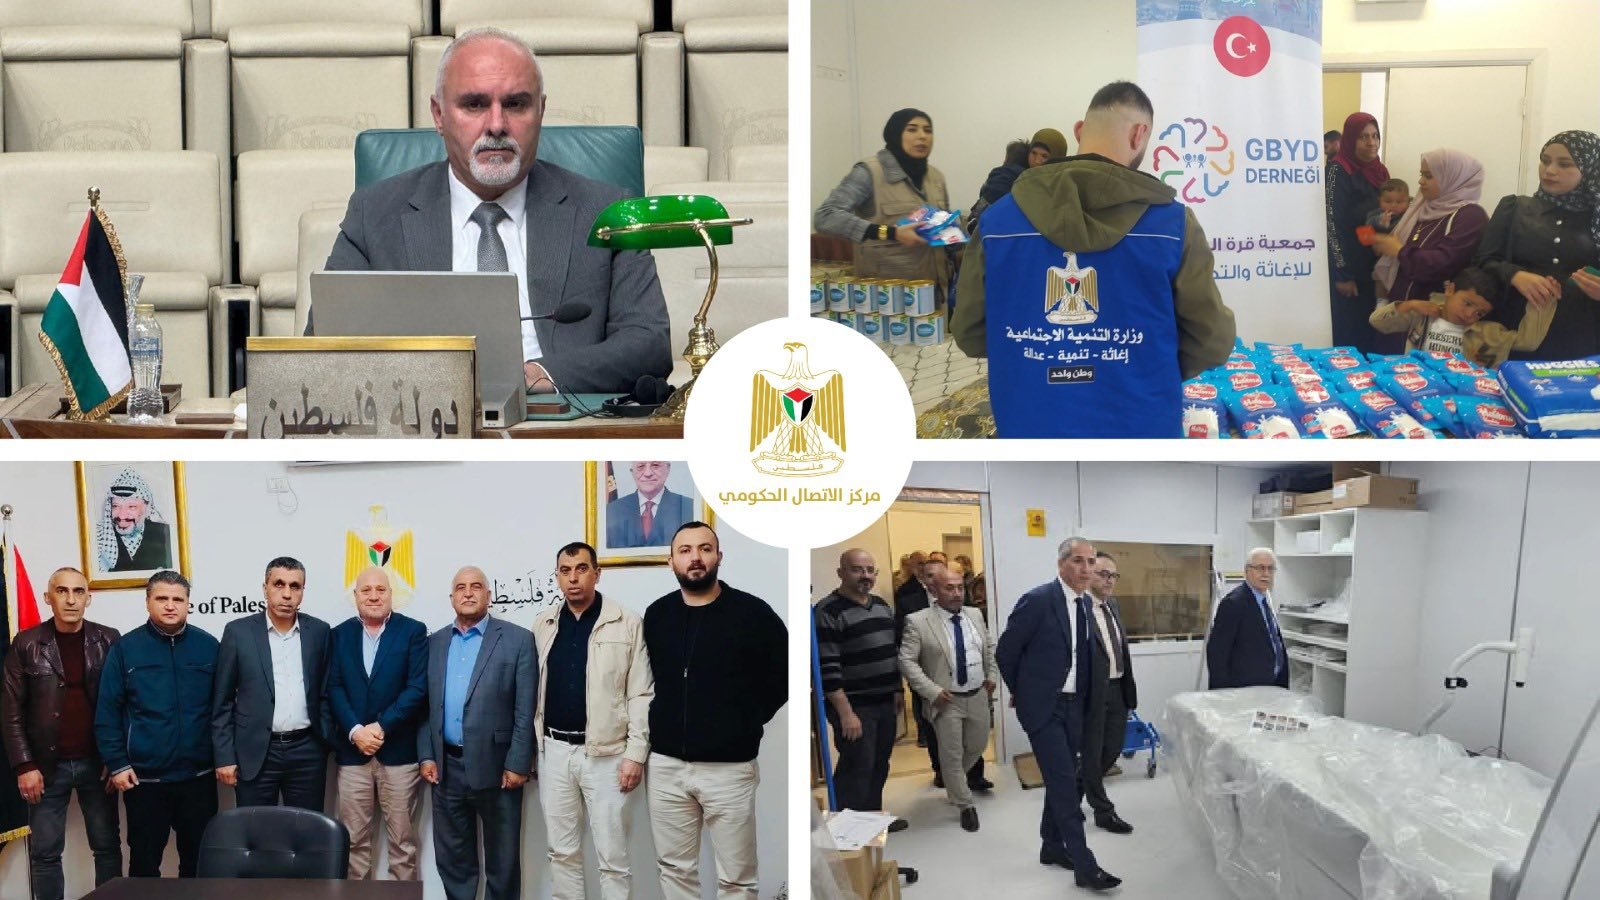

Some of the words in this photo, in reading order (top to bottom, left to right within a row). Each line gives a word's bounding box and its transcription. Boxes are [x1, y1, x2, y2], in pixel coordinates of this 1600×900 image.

[1245, 138, 1319, 162] GBYD
[1245, 165, 1320, 184] DERNEĞİ
[1226, 236, 1255, 253] قرة
[1258, 235, 1315, 252] جمعية
[1256, 260, 1312, 281] للإغاثة
[1006, 326, 1065, 345] الاجتماعية
[1067, 327, 1111, 344] التنمية
[1113, 328, 1144, 344] وزارة
[1023, 347, 1045, 361] عدالة
[1058, 348, 1090, 363] تنمية
[1101, 348, 1129, 364] إغاثة
[1050, 369, 1072, 379] واحد
[1072, 368, 1093, 379] وطن
[260, 380, 378, 439] فلسطين
[389, 380, 459, 439] دولة
[198, 596, 218, 614] of
